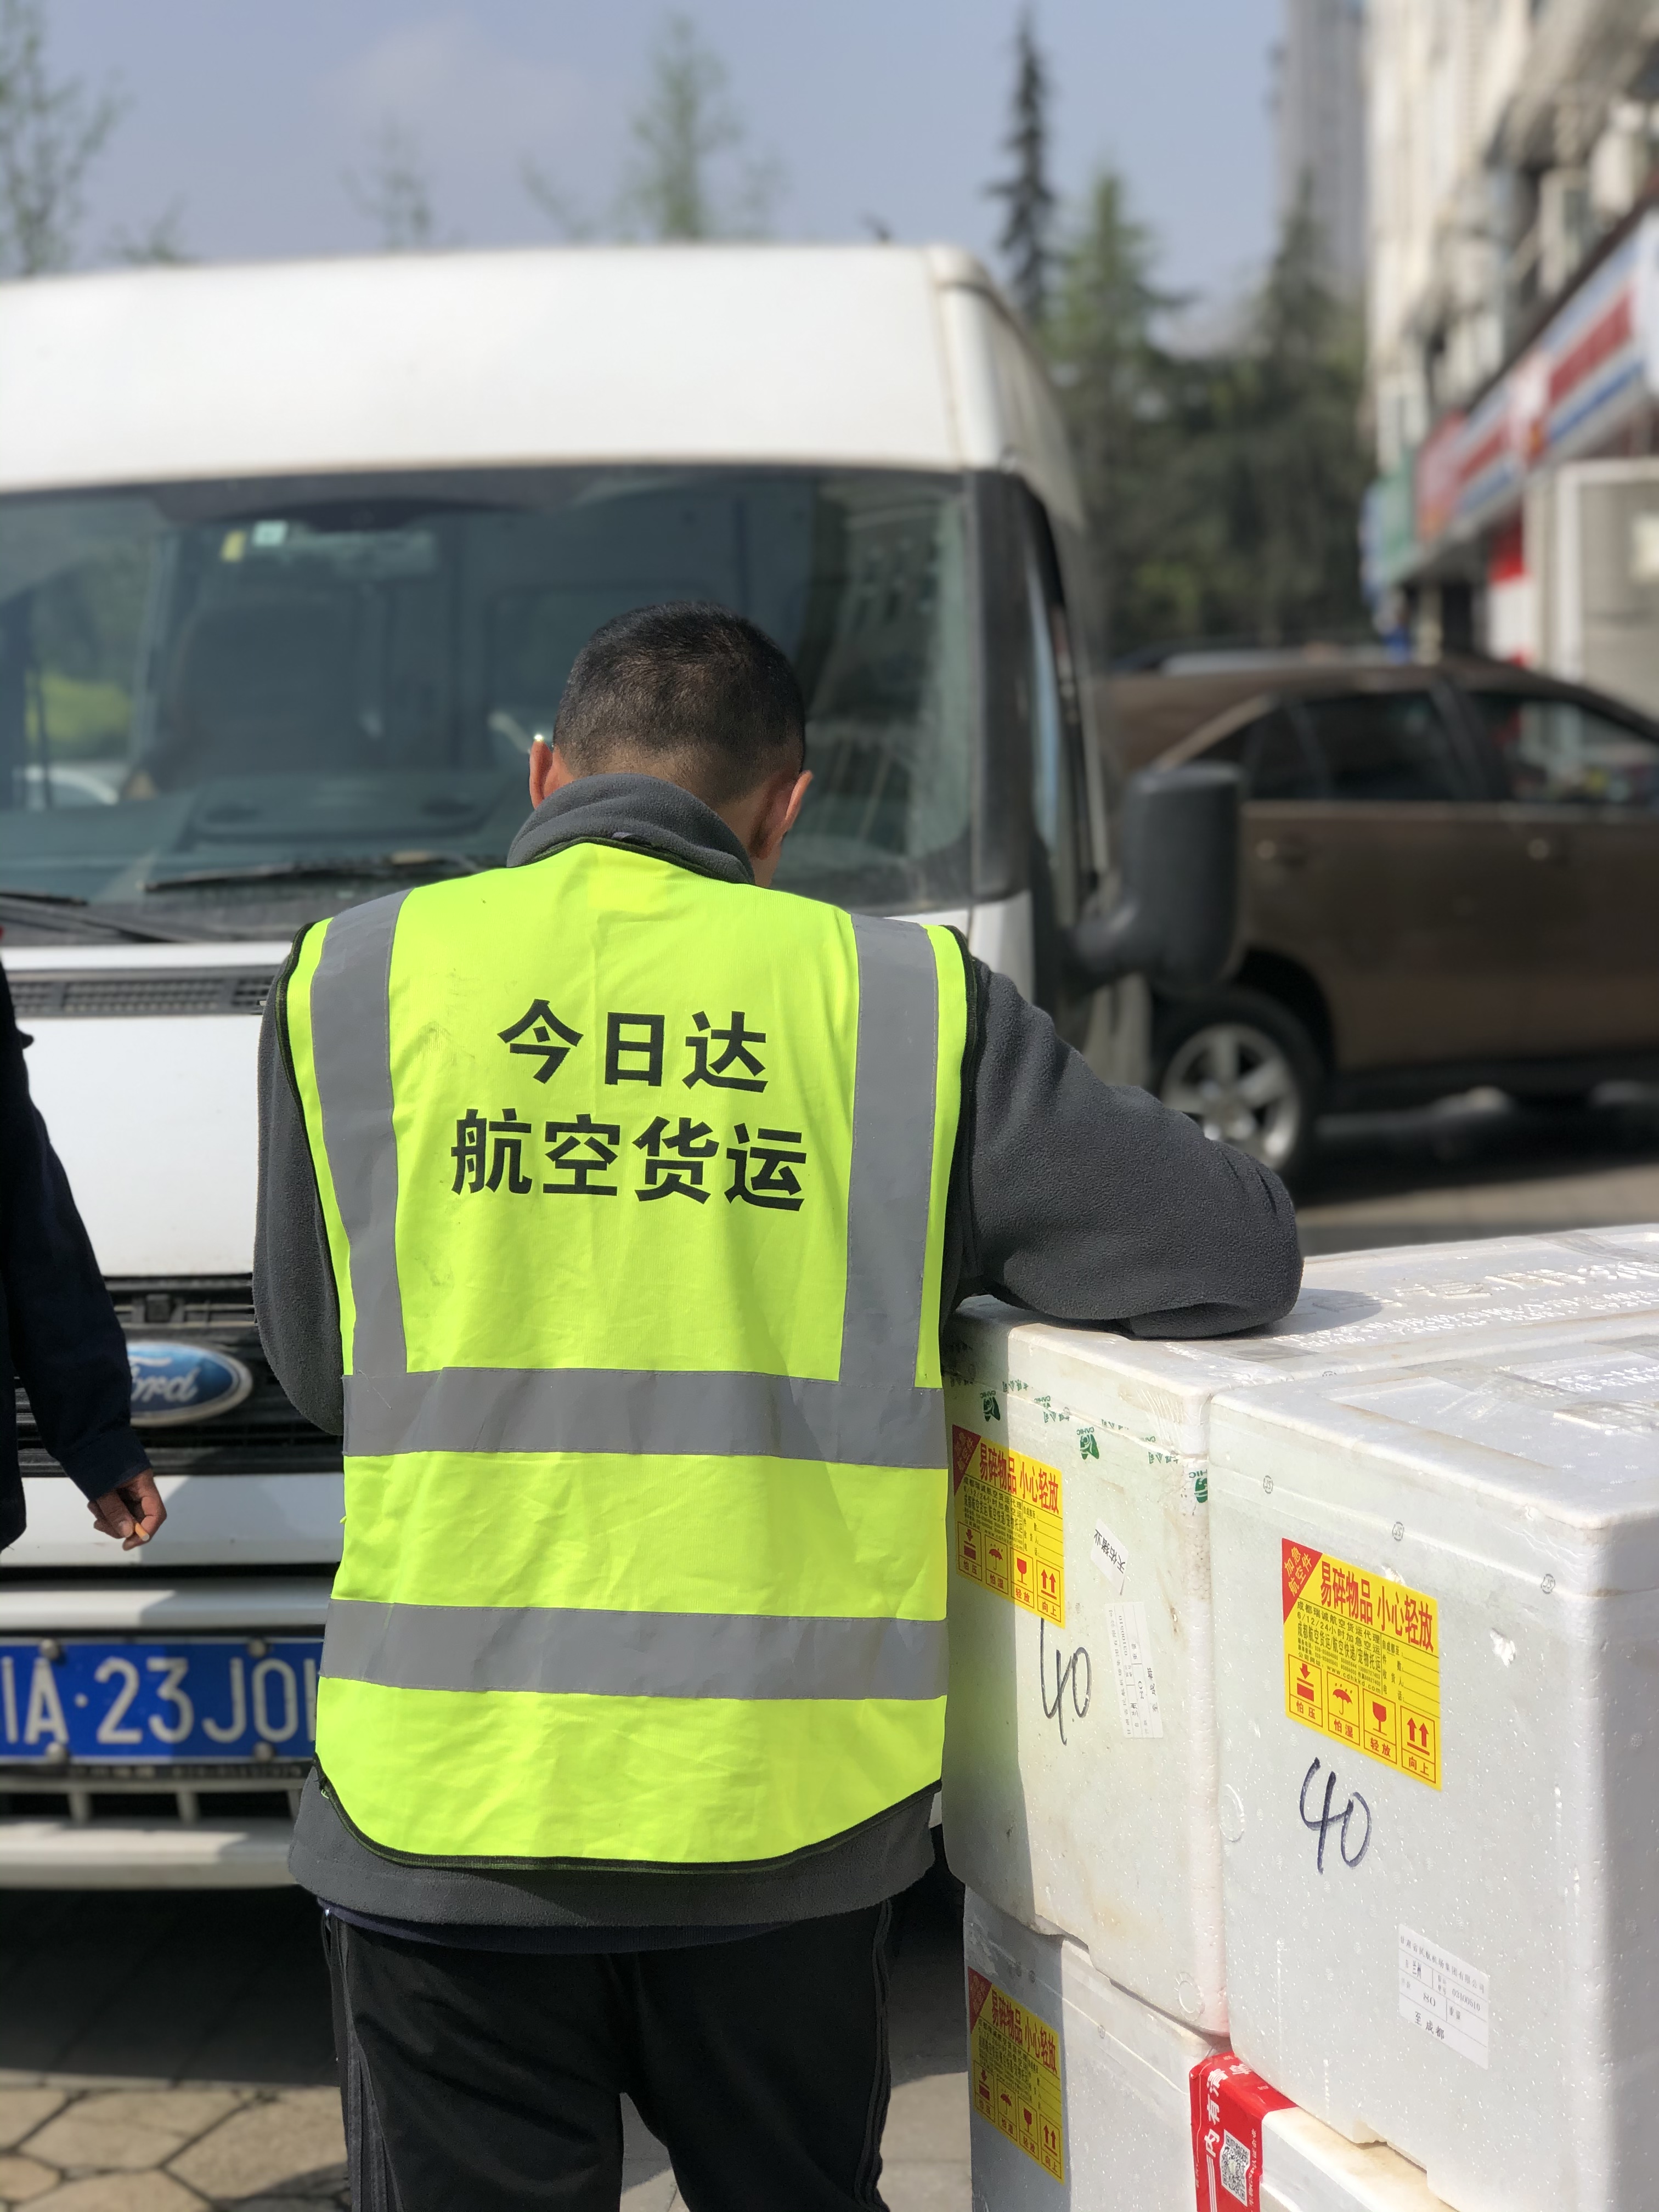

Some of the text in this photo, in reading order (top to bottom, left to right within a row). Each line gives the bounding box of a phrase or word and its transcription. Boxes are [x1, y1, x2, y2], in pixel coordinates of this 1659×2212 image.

[497, 998, 768, 1093] 今日达
[451, 1107, 806, 1212] 航空货运
[1076, 1426, 1094, 1436] CAHIC
[980, 1442, 1059, 1515] 易碎物品 小心轻放
[1094, 1528, 1125, 1574] 天佑猪业
[1284, 1547, 1301, 1577] 加急
[1015, 1588, 1030, 1603] 轻放
[1288, 1553, 1312, 1597] 航空件
[1042, 1601, 1057, 1617] 向上
[1297, 1601, 1380, 1644] 成都瑞诚航空货运代理
[1321, 1560, 1434, 1652] 易碎物品 小心轻放
[1297, 1611, 1380, 1655] 6/12/24小时加急空运
[1040, 1617, 1092, 1746] 40
[1296, 1700, 1316, 1719] 怕压
[1334, 1719, 1353, 1738] 怕湿
[1370, 1737, 1391, 1757] 轻放
[1408, 1756, 1429, 1776] 向上
[1300, 1757, 1372, 1875] 40
[1452, 1988, 1481, 2012] 03100510
[1025, 2016, 1057, 2074] 小心轻放
[1425, 2020, 1444, 2040] 成都
[1204, 2063, 1251, 2157] 内有清单
